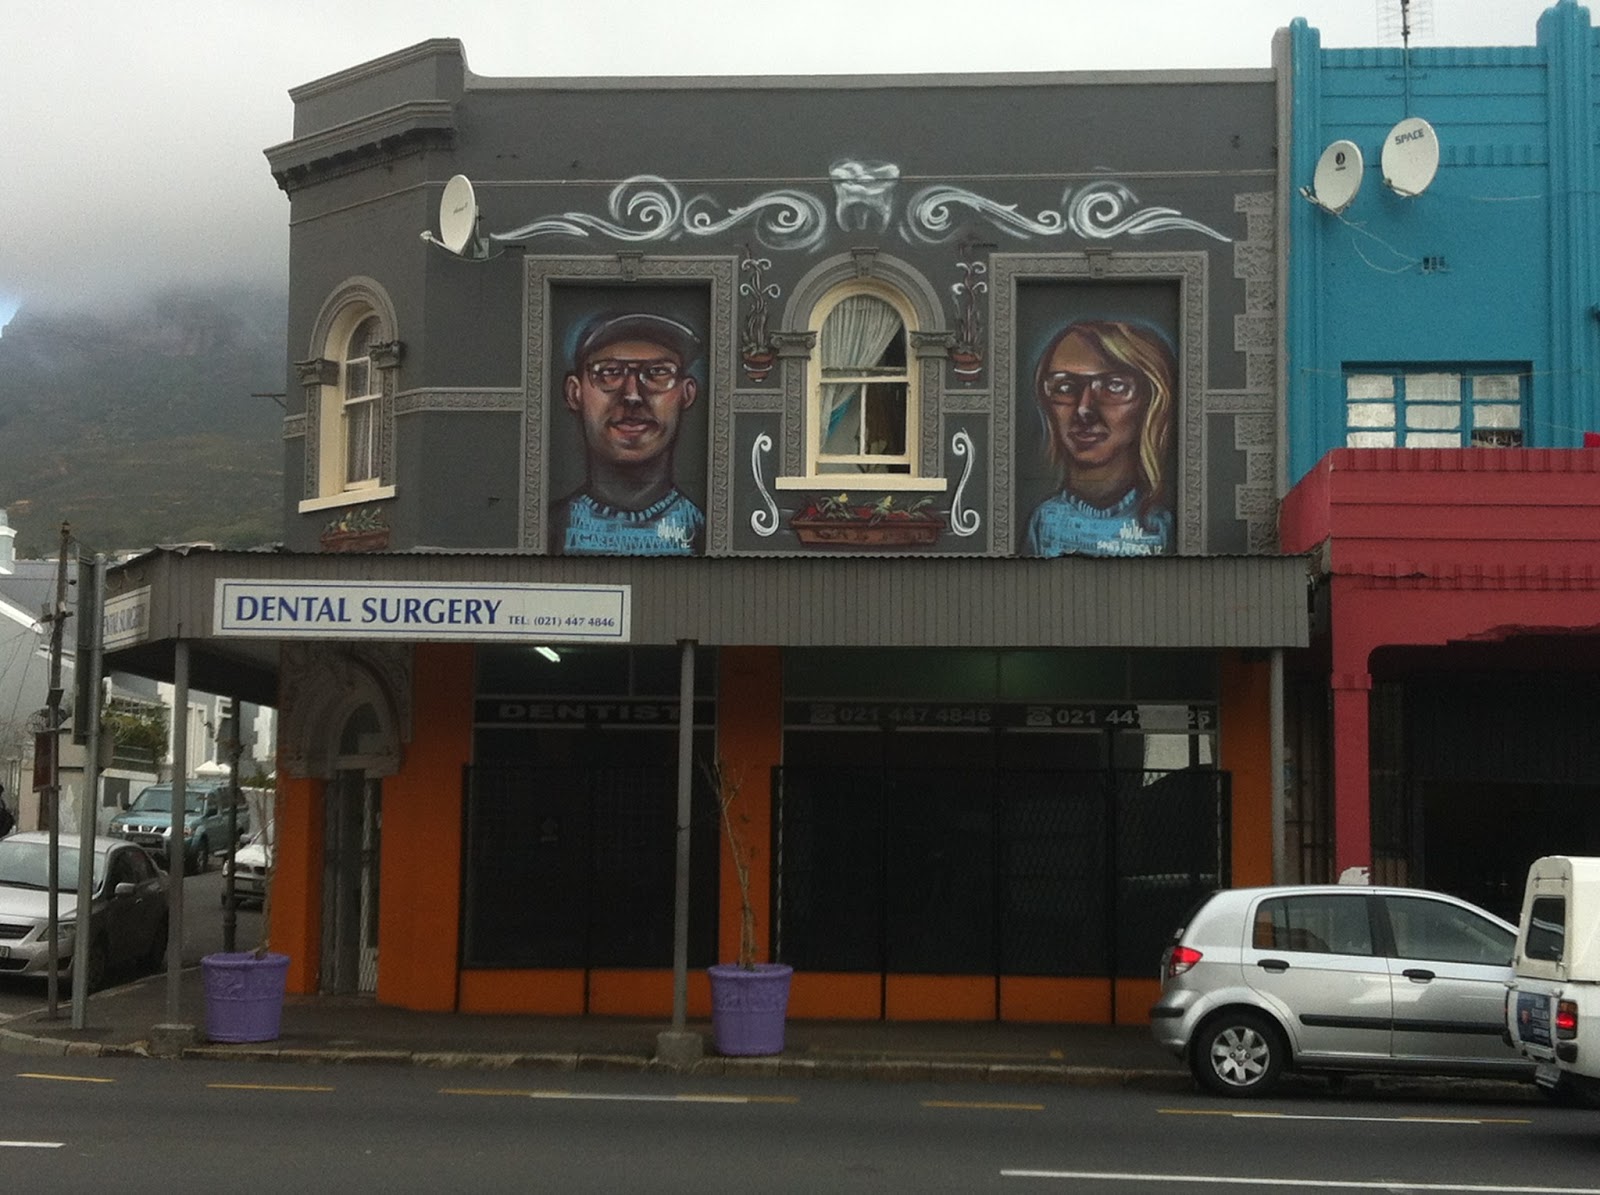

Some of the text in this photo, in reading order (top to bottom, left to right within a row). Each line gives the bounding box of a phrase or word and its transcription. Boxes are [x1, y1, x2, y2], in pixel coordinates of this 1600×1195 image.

[1395, 127, 1425, 145] SPACE
[236, 596, 352, 622] DENTAL
[361, 597, 502, 625] SURGERY
[534, 616, 561, 627] (021)
[565, 617, 585, 627] 447
[588, 617, 615, 627] 4846
[499, 704, 681, 719] DENTIST
[839, 708, 992, 722] 021 447 4846
[1056, 709, 1097, 724] 021
